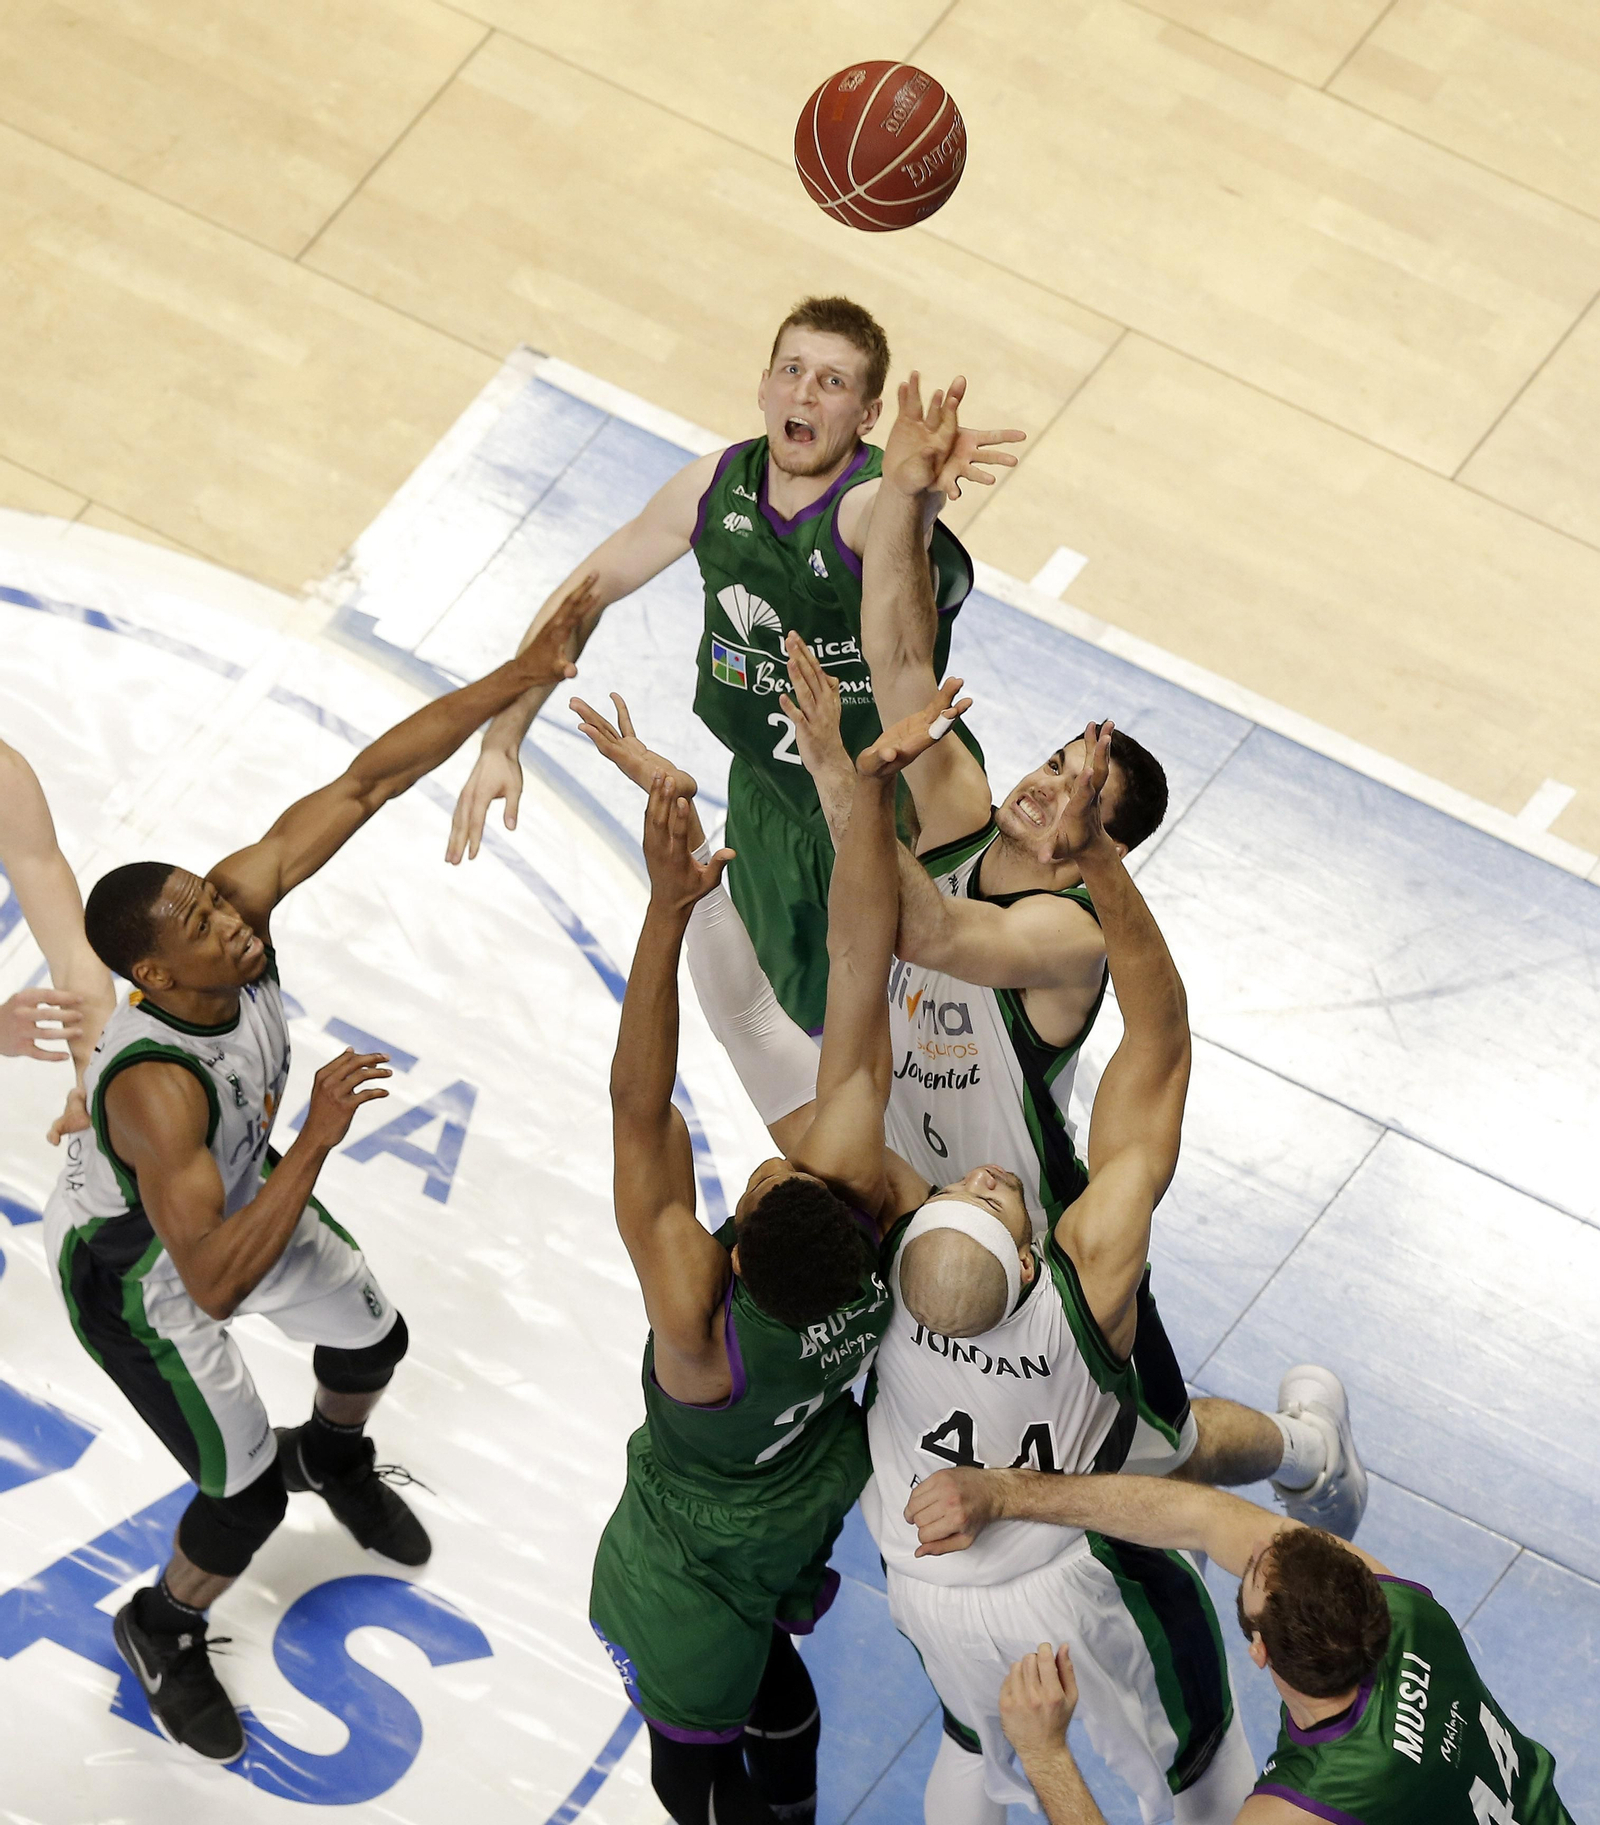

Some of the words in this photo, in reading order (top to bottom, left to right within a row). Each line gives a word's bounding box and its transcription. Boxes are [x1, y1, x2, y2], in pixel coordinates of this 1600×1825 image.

[894, 1051, 981, 1090] Joventut
[923, 1112, 948, 1159] 6
[820, 1331, 877, 1369] Málaga
[915, 1408, 1063, 1474] 44
[1393, 1652, 1432, 1765] MUSLI
[1440, 1700, 1468, 1763] Málaga
